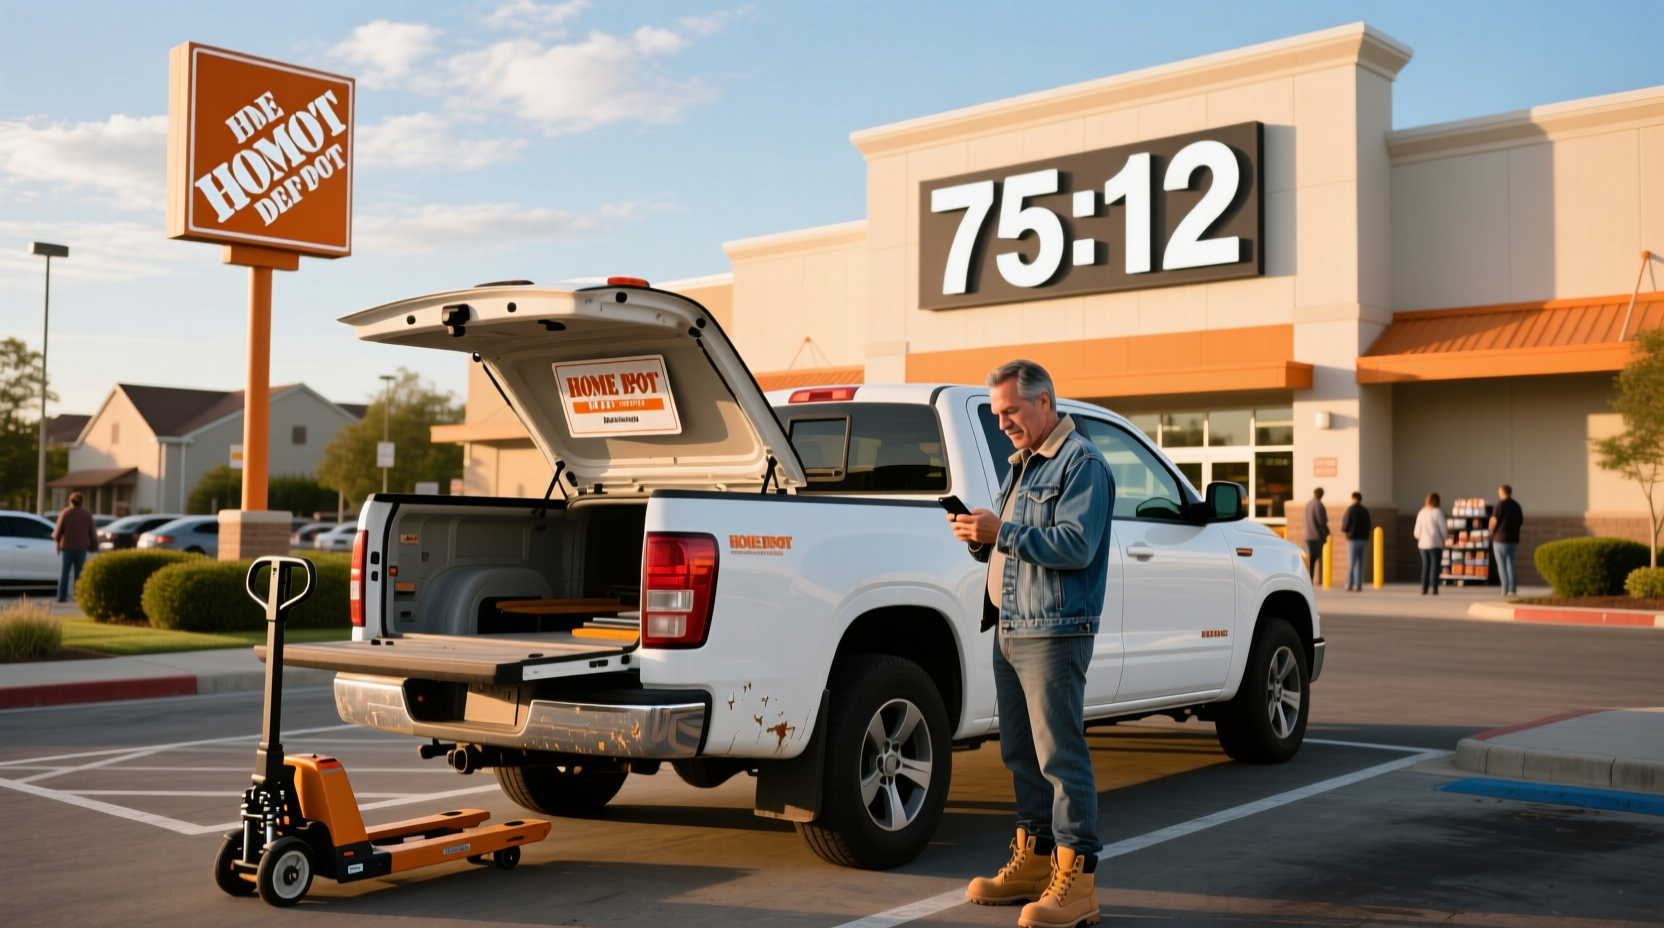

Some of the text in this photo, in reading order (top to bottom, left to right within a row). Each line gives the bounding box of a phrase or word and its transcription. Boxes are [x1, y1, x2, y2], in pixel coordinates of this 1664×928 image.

[194, 89, 347, 224] HOMOT
[931, 139, 1240, 295] 75:12
[566, 373, 620, 398] HOME
